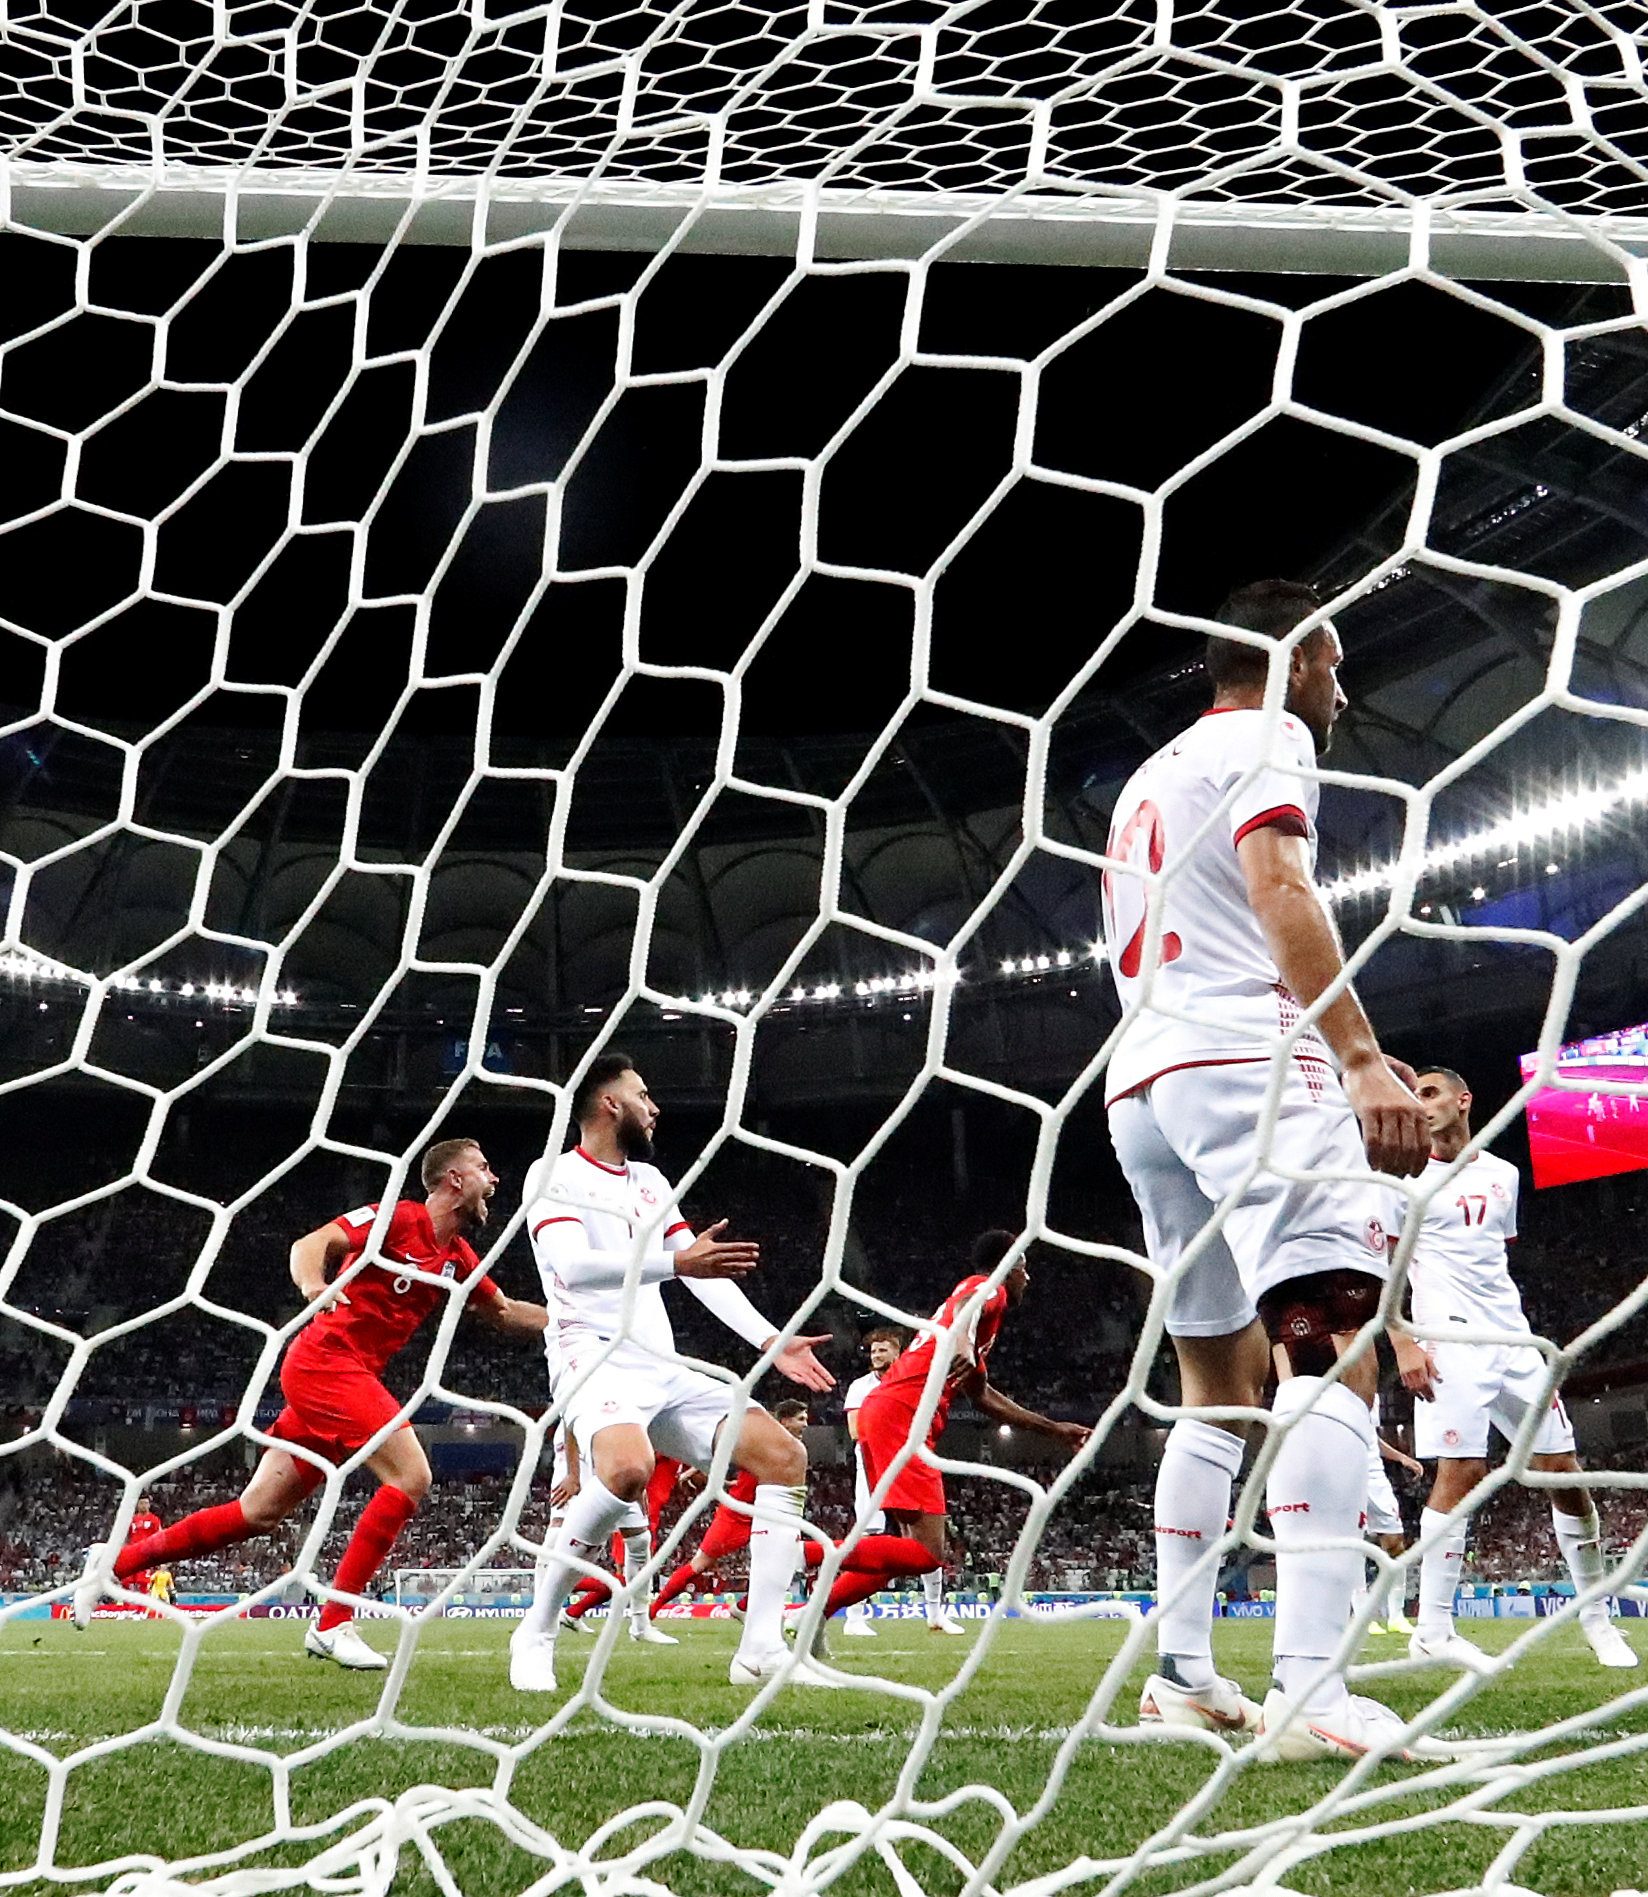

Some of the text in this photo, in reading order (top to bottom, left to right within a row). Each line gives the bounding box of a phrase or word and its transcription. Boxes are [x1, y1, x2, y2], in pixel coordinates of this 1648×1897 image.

[1456, 1195, 1487, 1226] 17
[268, 1605, 322, 1620] QATA
[475, 1608, 527, 1618] HYUND
[877, 1603, 925, 1619] 万达
[926, 1604, 1007, 1619] WAND
